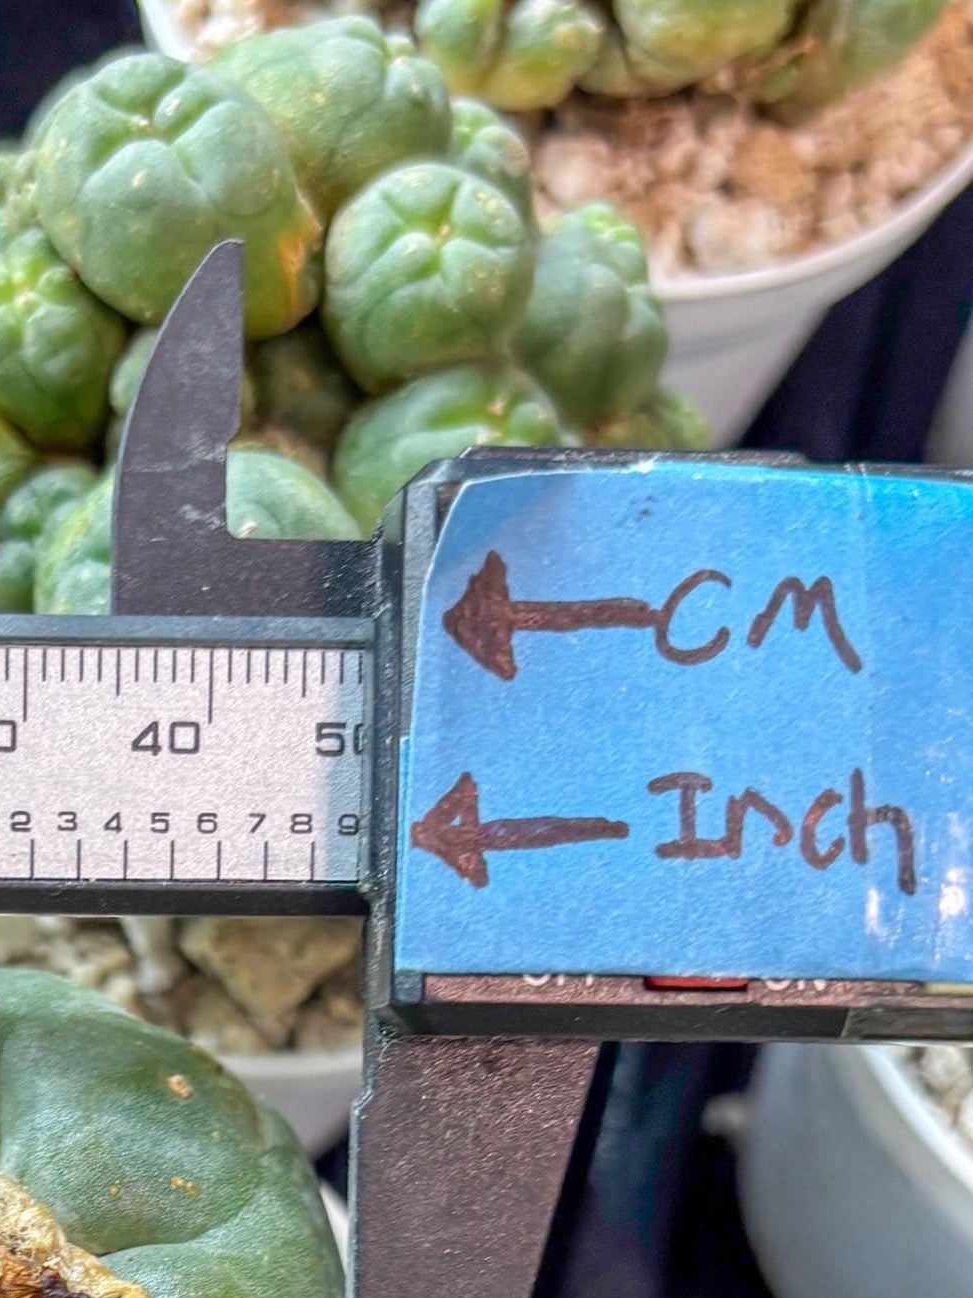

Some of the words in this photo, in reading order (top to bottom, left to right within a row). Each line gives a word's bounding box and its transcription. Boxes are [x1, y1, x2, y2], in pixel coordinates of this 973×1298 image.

[131, 721, 200, 756] 40
[10, 811, 32, 832] 2
[57, 812, 77, 832] 3
[103, 813, 123, 833] 4
[150, 813, 171, 834] 5
[197, 813, 218, 834] 6
[246, 814, 267, 834] 7
[290, 814, 313, 834] 8
[338, 814, 359, 836] 9
[647, 768, 917, 896] Inch
